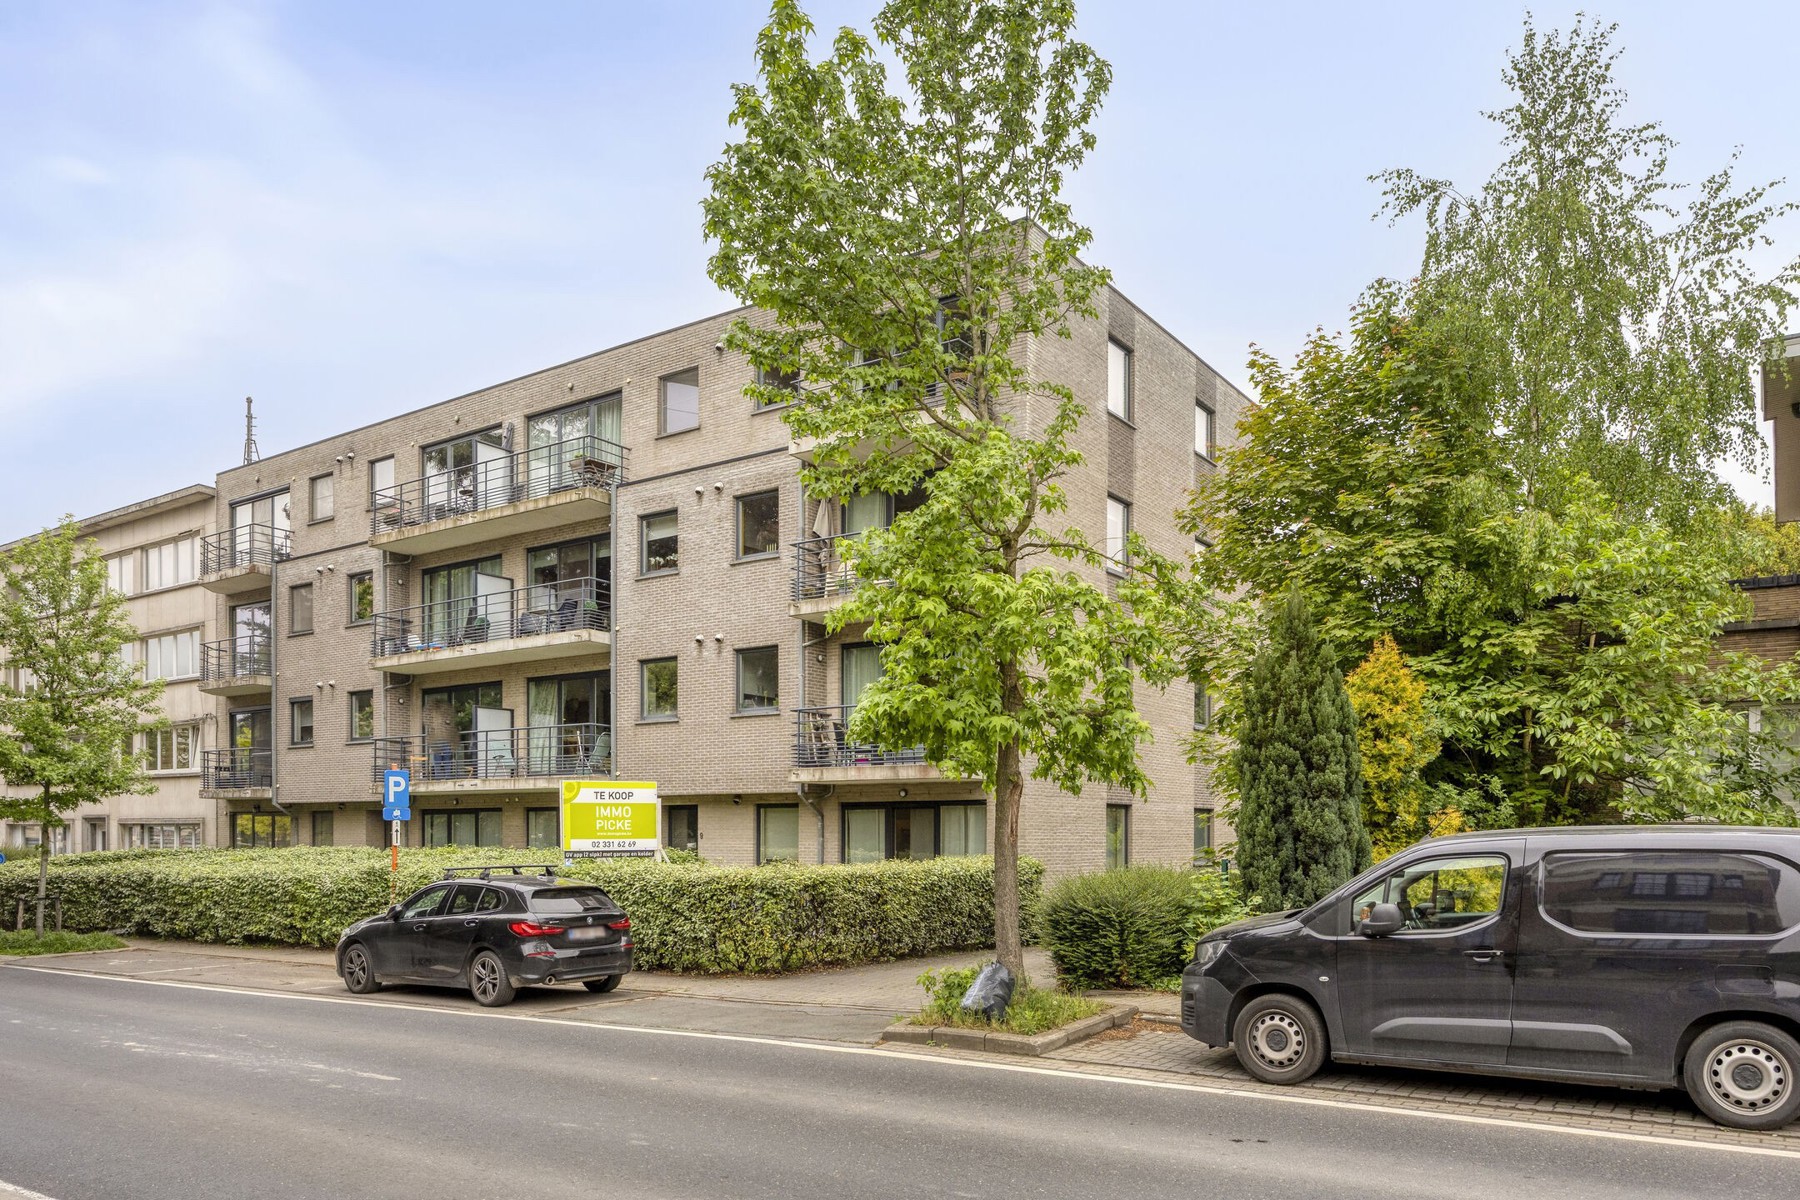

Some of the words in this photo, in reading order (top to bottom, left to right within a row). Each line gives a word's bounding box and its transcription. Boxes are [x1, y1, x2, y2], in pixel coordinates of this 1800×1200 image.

[386, 774, 402, 798] P
[593, 791, 606, 800] TE
[608, 791, 634, 800] KOOP
[596, 807, 632, 818] IMMO
[596, 820, 632, 830] PICKE
